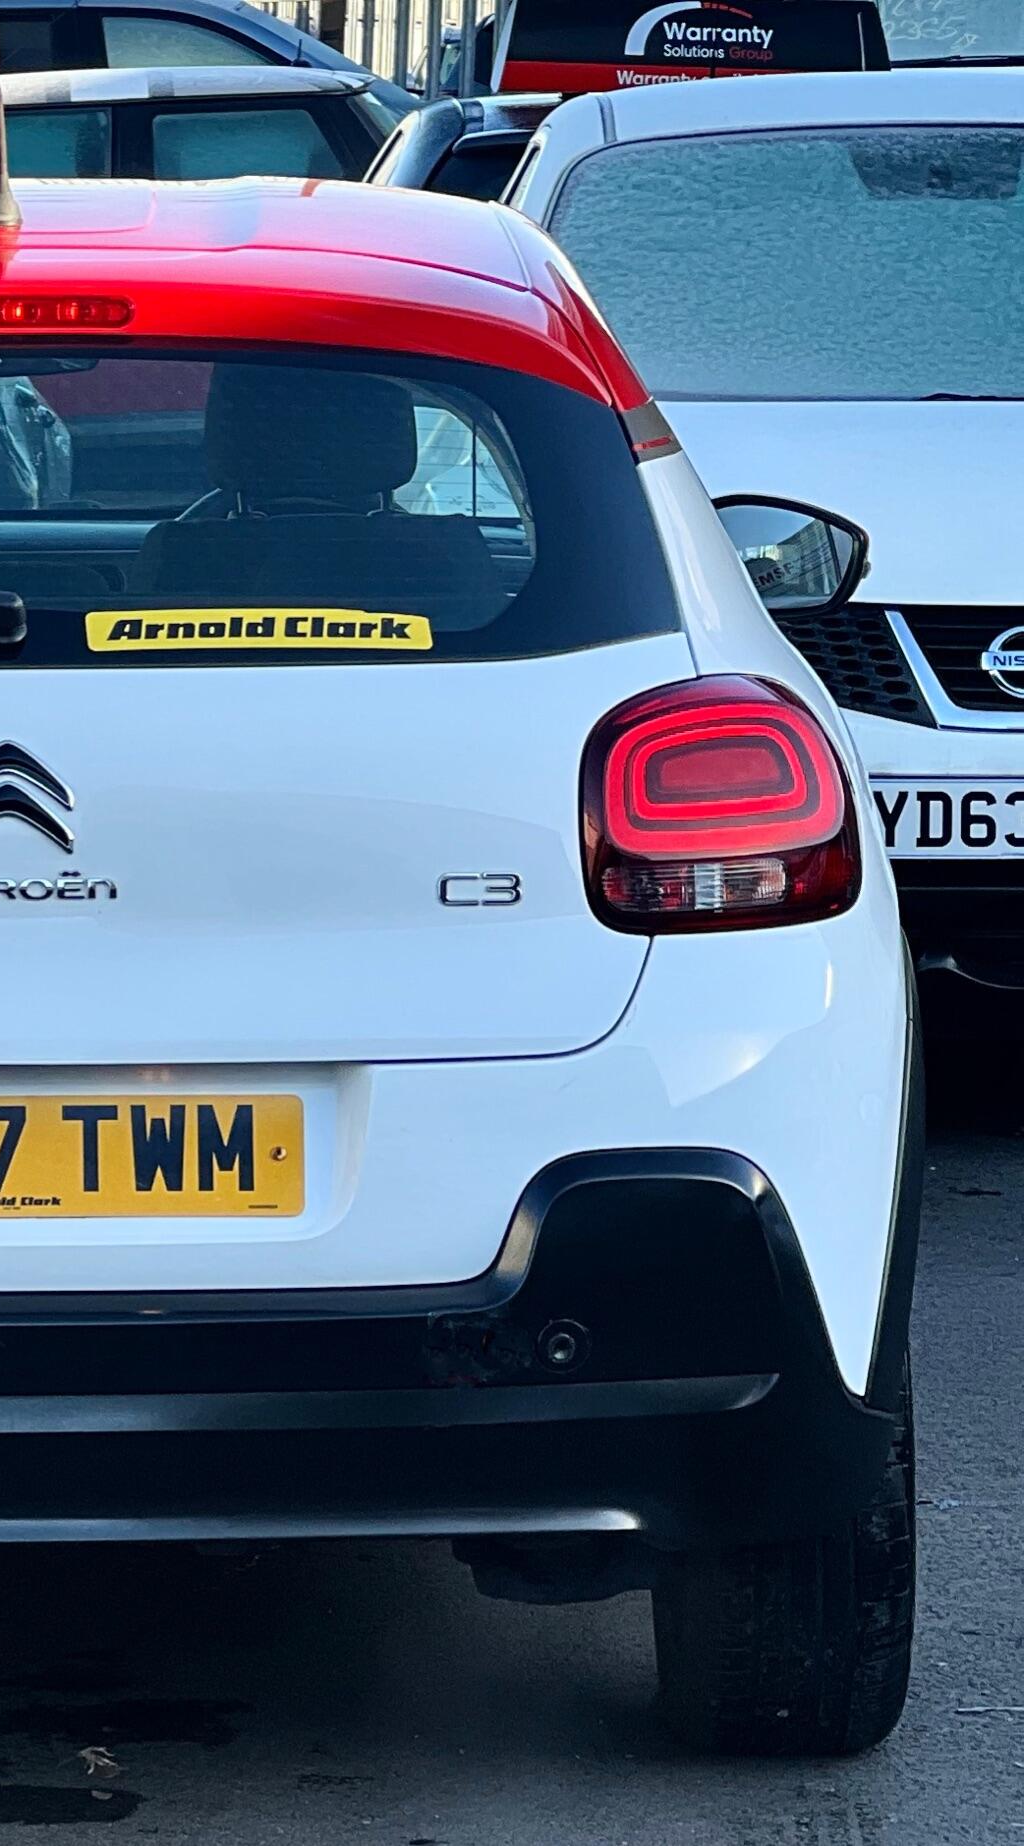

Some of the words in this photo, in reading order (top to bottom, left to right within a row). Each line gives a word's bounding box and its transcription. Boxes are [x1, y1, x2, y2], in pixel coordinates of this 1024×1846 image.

[663, 22, 774, 48] Warranty
[663, 44, 725, 58] Solutions
[729, 46, 774, 61] Group
[106, 616, 276, 641] Arnold
[284, 616, 412, 639] Clark
[437, 872, 522, 907] C3
[62, 1104, 255, 1193] TWM
[21, 1196, 61, 1206] Clark
